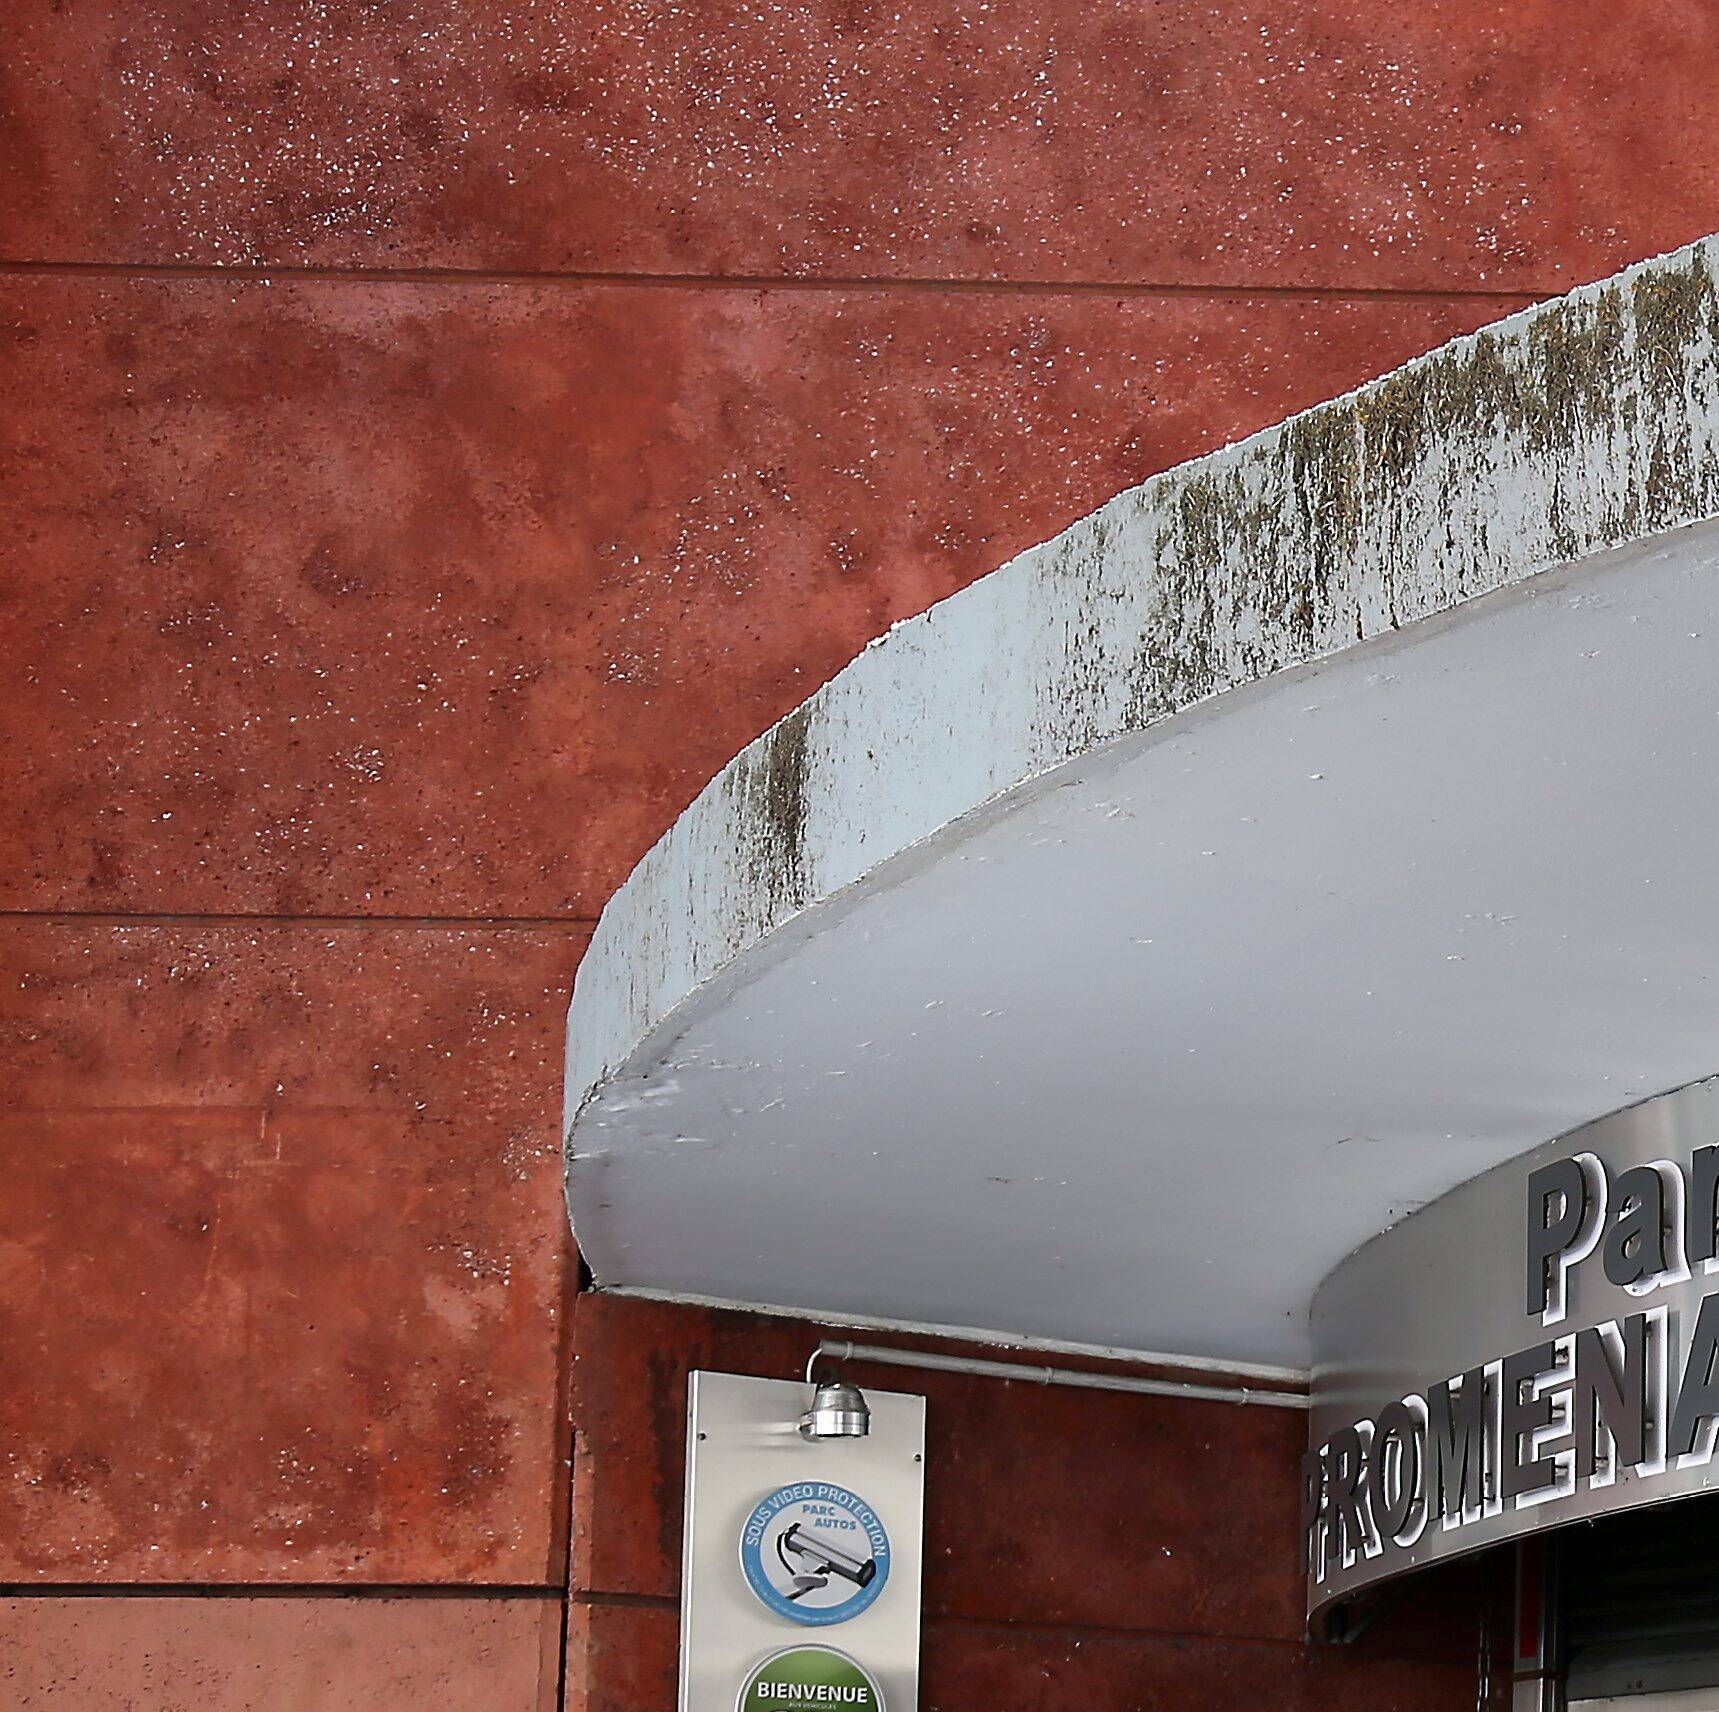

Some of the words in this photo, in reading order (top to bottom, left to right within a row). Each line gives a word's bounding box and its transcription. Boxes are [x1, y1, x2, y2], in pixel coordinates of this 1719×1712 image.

[802, 1504, 836, 1516] PARC
[746, 1506, 772, 1546] SOUS
[767, 1485, 813, 1509] VIDEO
[818, 1485, 886, 1557] PROTECTION
[815, 1518, 856, 1530] AUTOS
[757, 1681, 868, 1703] BIENVENUE
